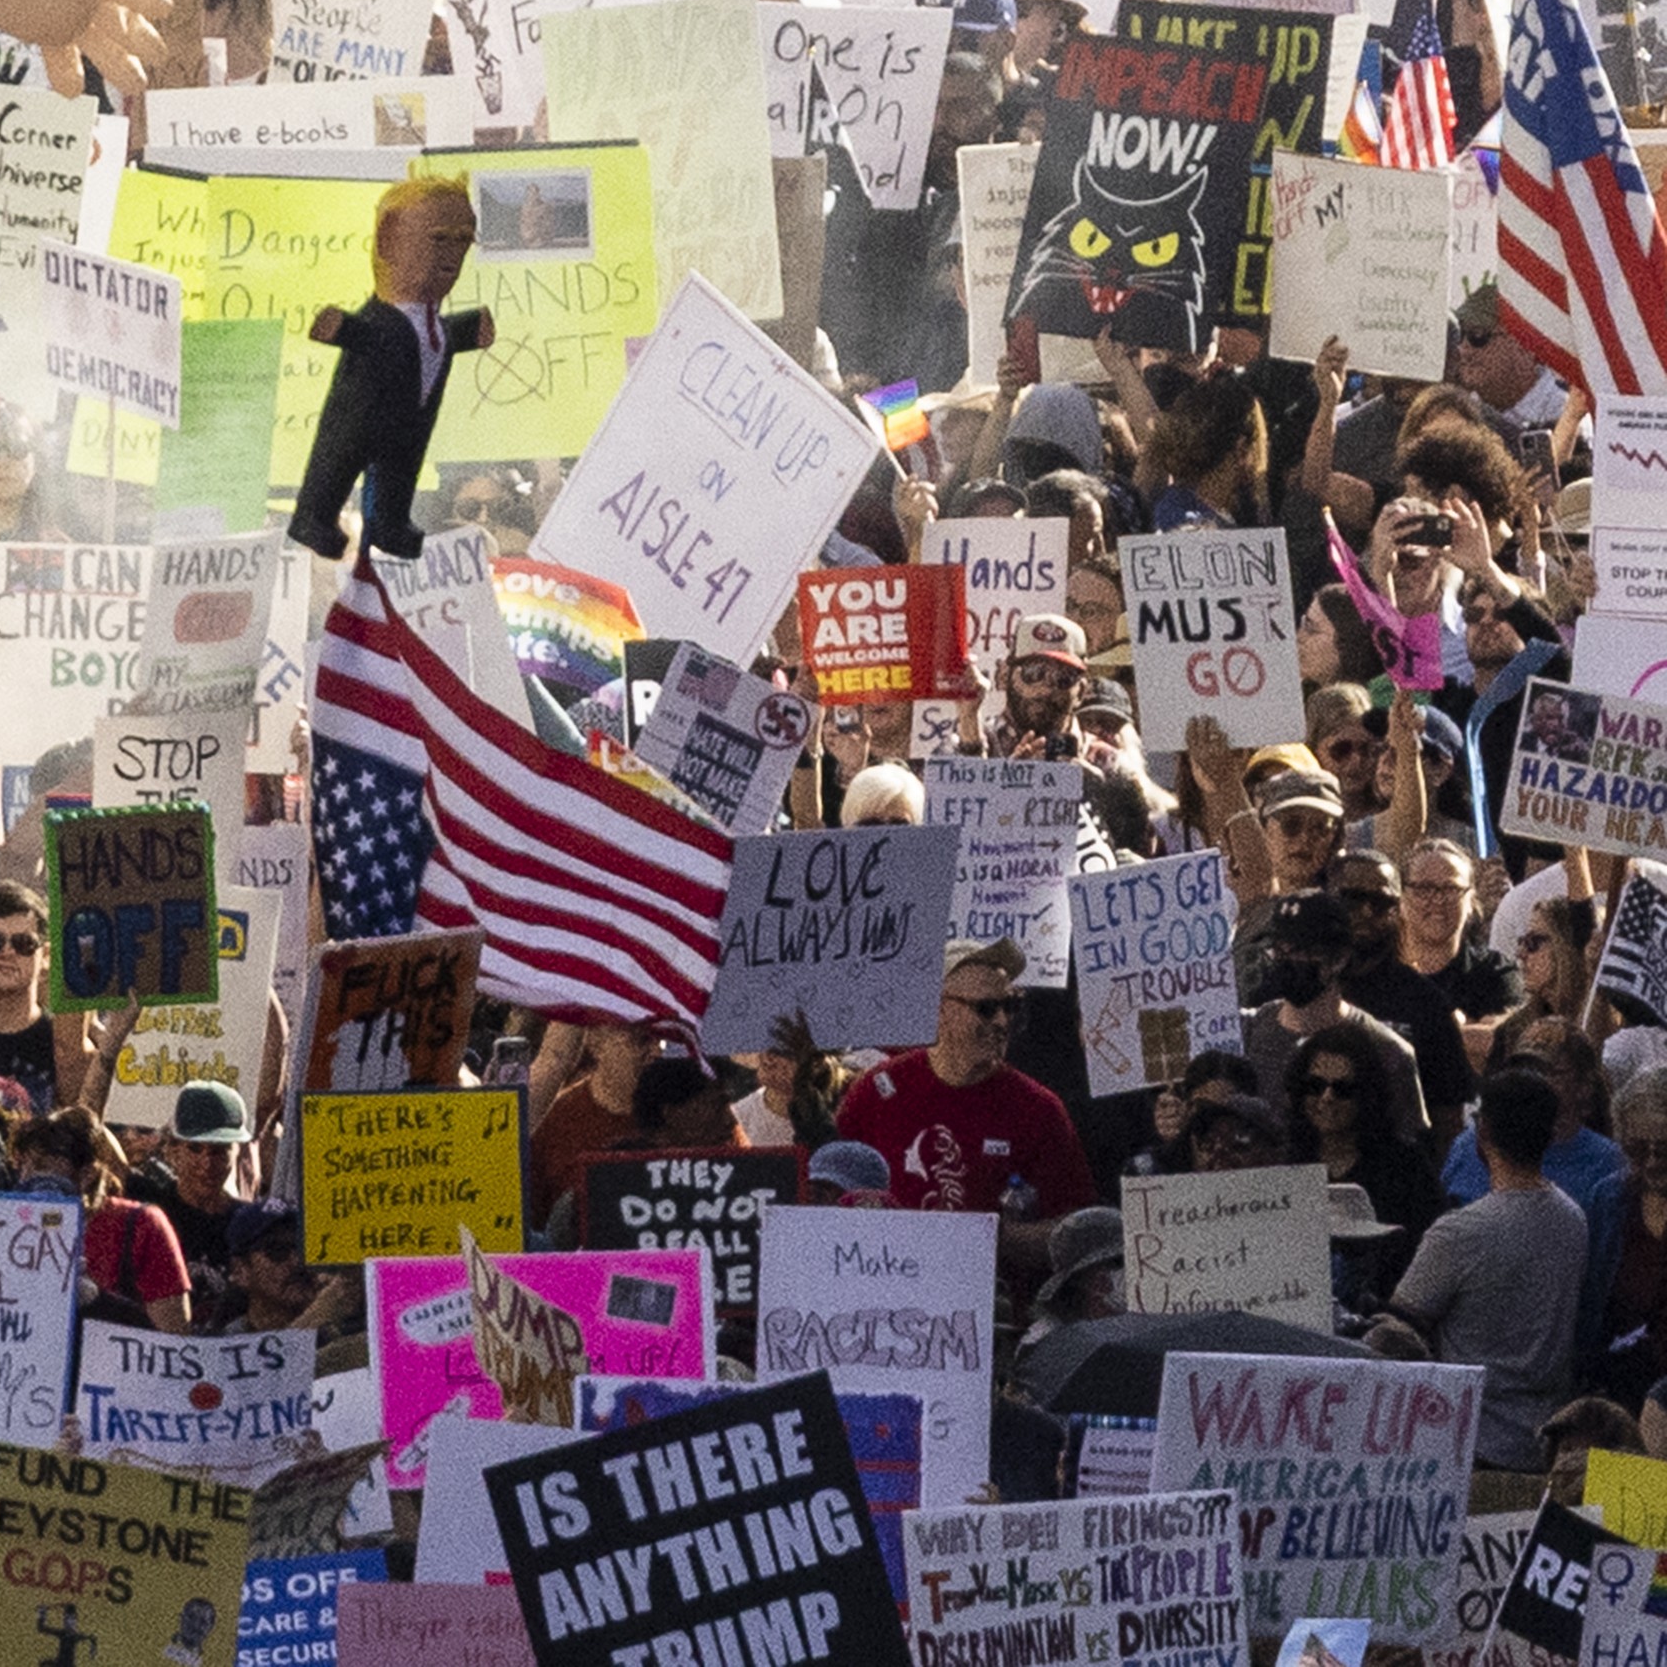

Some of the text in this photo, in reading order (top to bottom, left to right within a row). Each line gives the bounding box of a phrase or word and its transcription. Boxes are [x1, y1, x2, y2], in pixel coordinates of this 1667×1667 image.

[170, 120, 348, 146] I have e-books
[1088, 114, 1215, 174] NOW!
[45, 255, 169, 319] DICTATOR
[47, 348, 178, 421] DEMOCRACY
[600, 470, 753, 623] AISLE 47
[809, 579, 905, 611] YOU
[814, 616, 907, 646] ARE
[816, 649, 909, 666] WELCOME
[819, 668, 911, 692] HERE
[765, 840, 886, 906] LOVE
[324, 1141, 452, 1176] SOMETHING
[646, 1161, 734, 1192] THEY
[331, 1183, 480, 1216] HAPPENING
[112, 1335, 284, 1378] THIS IS
[515, 1409, 814, 1547] IS THERE
[538, 1488, 863, 1640] ANYTHING
